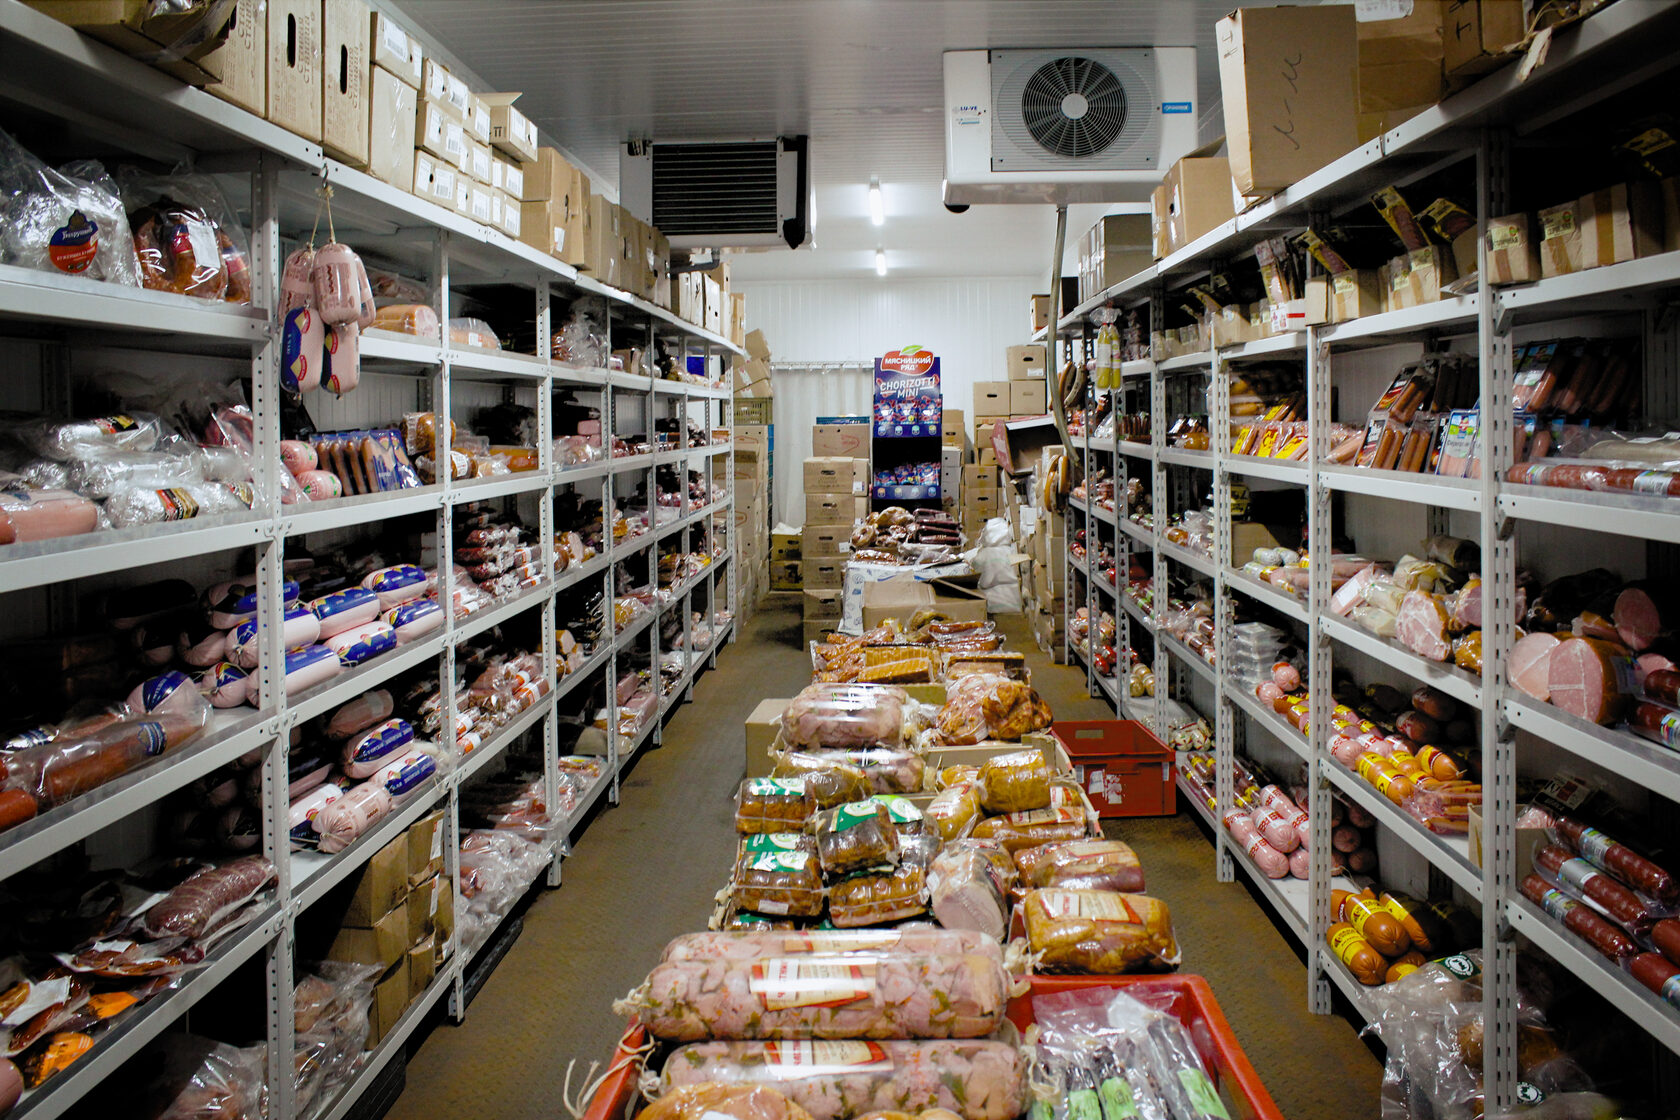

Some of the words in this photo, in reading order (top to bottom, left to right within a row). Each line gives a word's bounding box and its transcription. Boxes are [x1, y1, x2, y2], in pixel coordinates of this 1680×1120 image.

[884, 355, 931, 364] МЯСНИЦКИЙ
[880, 376, 935, 391] CHORIZOTTI
[897, 387, 919, 398] MINI
